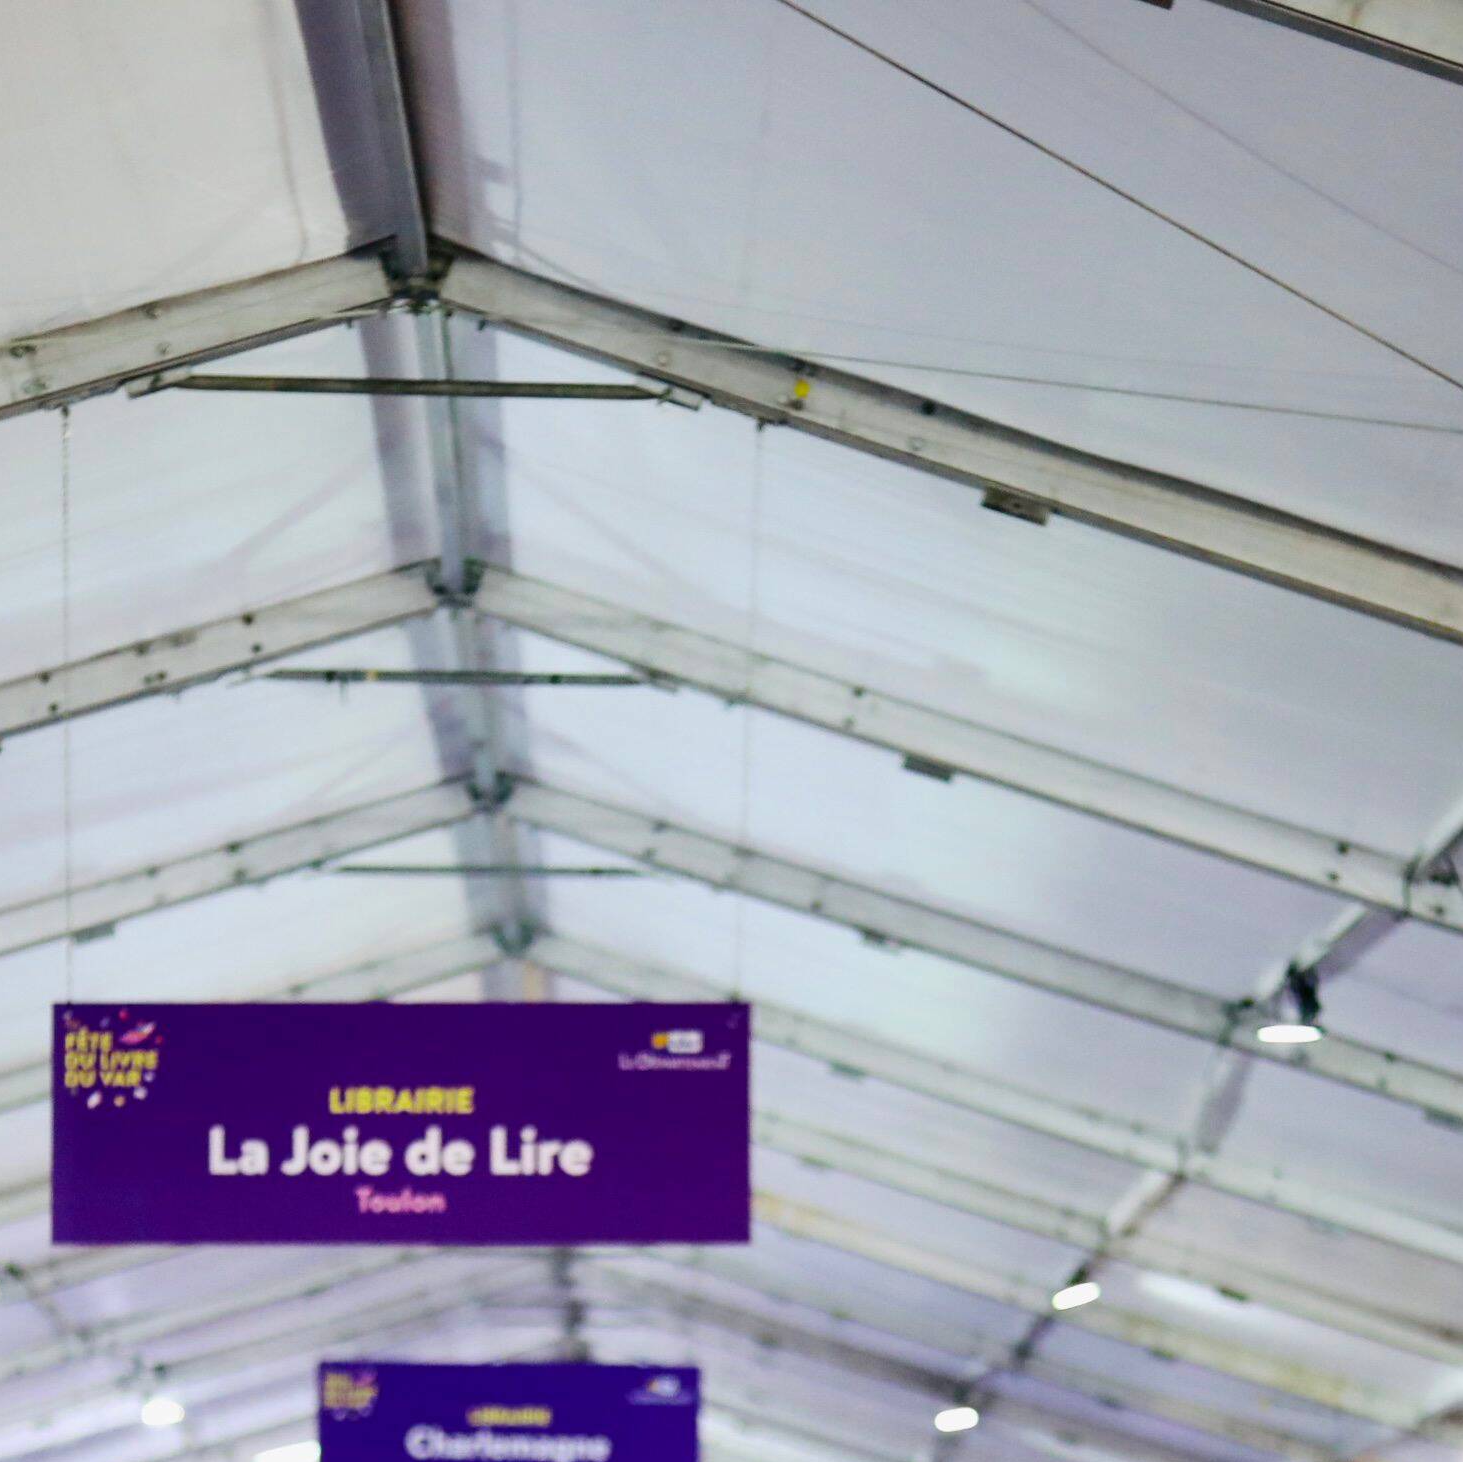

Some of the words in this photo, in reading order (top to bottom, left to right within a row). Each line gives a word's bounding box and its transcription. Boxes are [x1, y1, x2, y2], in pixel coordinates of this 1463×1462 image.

[65, 1026, 113, 1052] FÊTE
[64, 1051, 96, 1070] DU
[64, 1070, 96, 1089] DU
[100, 1070, 142, 1088] VAR
[329, 1086, 475, 1114] LIBRAIRIE
[208, 1125, 268, 1176] La
[281, 1125, 392, 1176] Joie
[405, 1125, 475, 1176] de
[490, 1125, 594, 1176] Lire
[356, 1187, 446, 1214] Toulon
